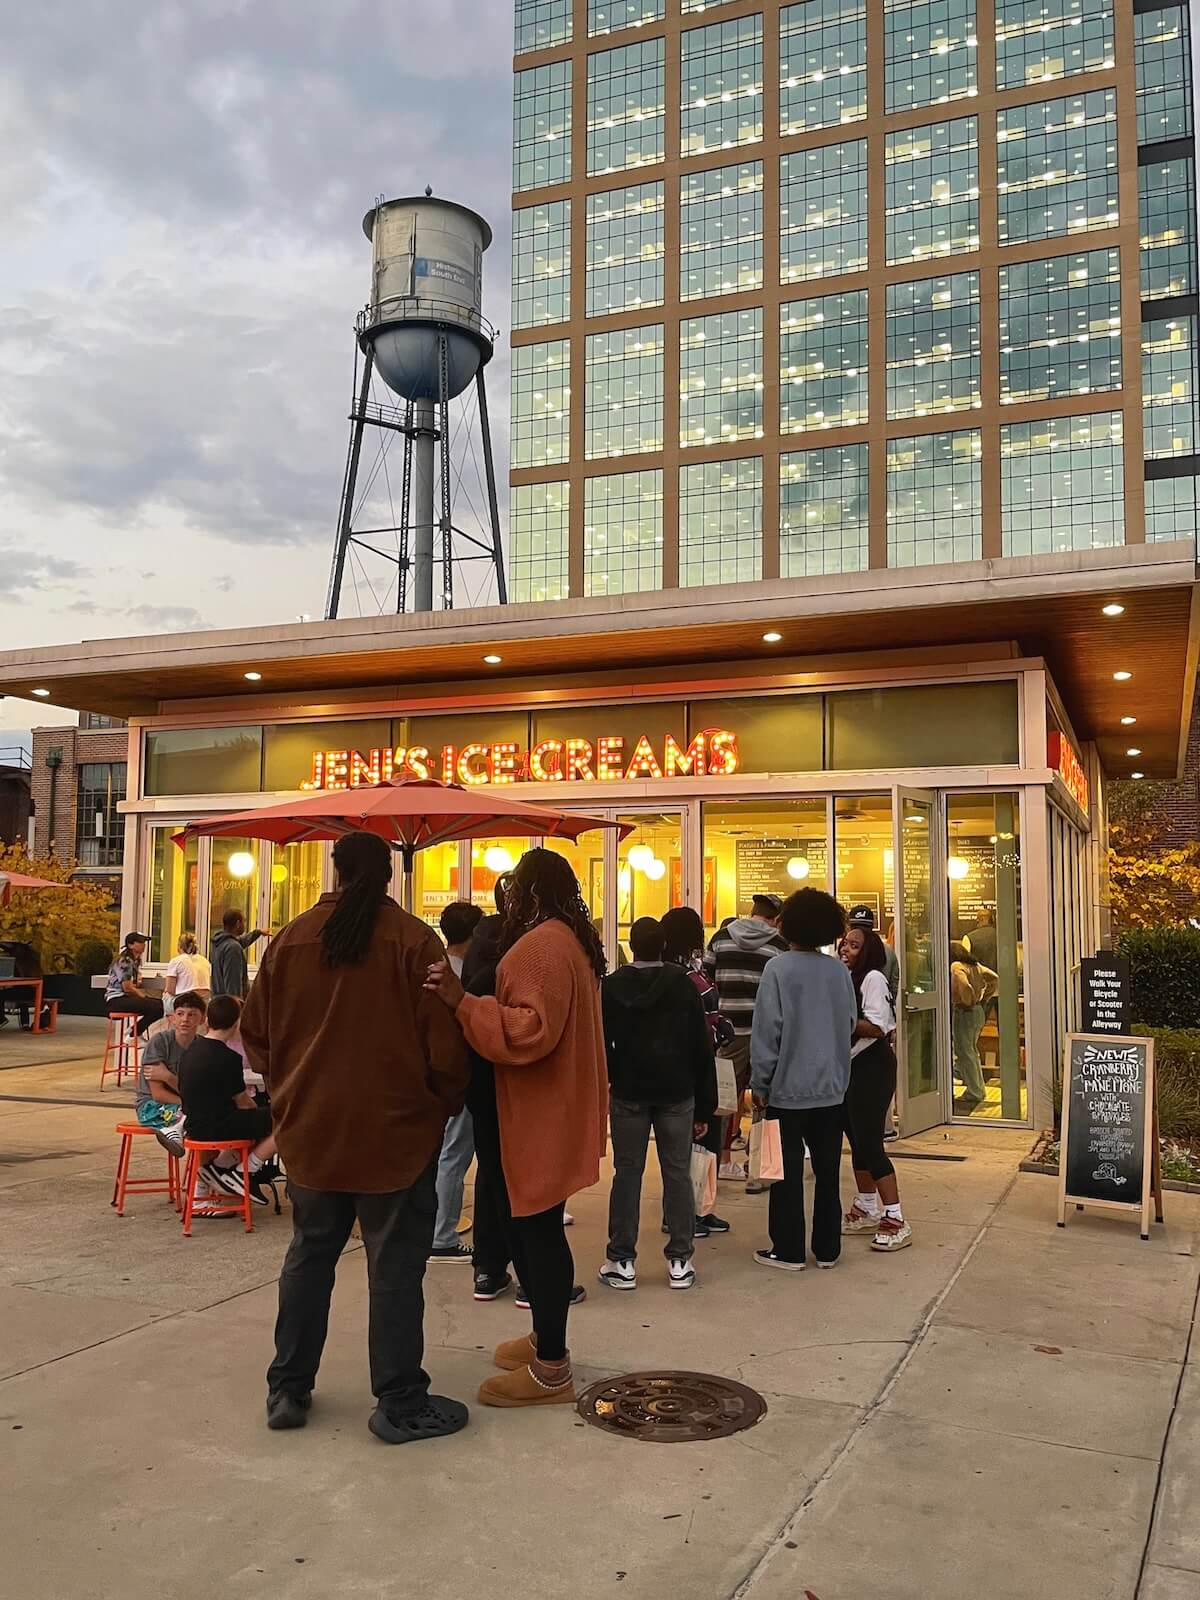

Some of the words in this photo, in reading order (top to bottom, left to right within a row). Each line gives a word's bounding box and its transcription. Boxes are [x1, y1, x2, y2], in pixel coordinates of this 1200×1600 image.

[299, 746, 429, 790] JENI'S
[442, 743, 518, 785] ICE
[530, 728, 739, 783] CREAMS
[1093, 969, 1117, 978] Please
[1089, 979, 1106, 988] Walk
[1106, 979, 1121, 988] Your
[1093, 989, 1118, 999] Bicycle
[1089, 1000, 1097, 1008] or
[1097, 1000, 1123, 1008] Scooter
[1104, 1010, 1117, 1018] the
[1092, 1020, 1122, 1030] Alleyway
[1082, 1062, 1139, 1081] CRANBERRY
